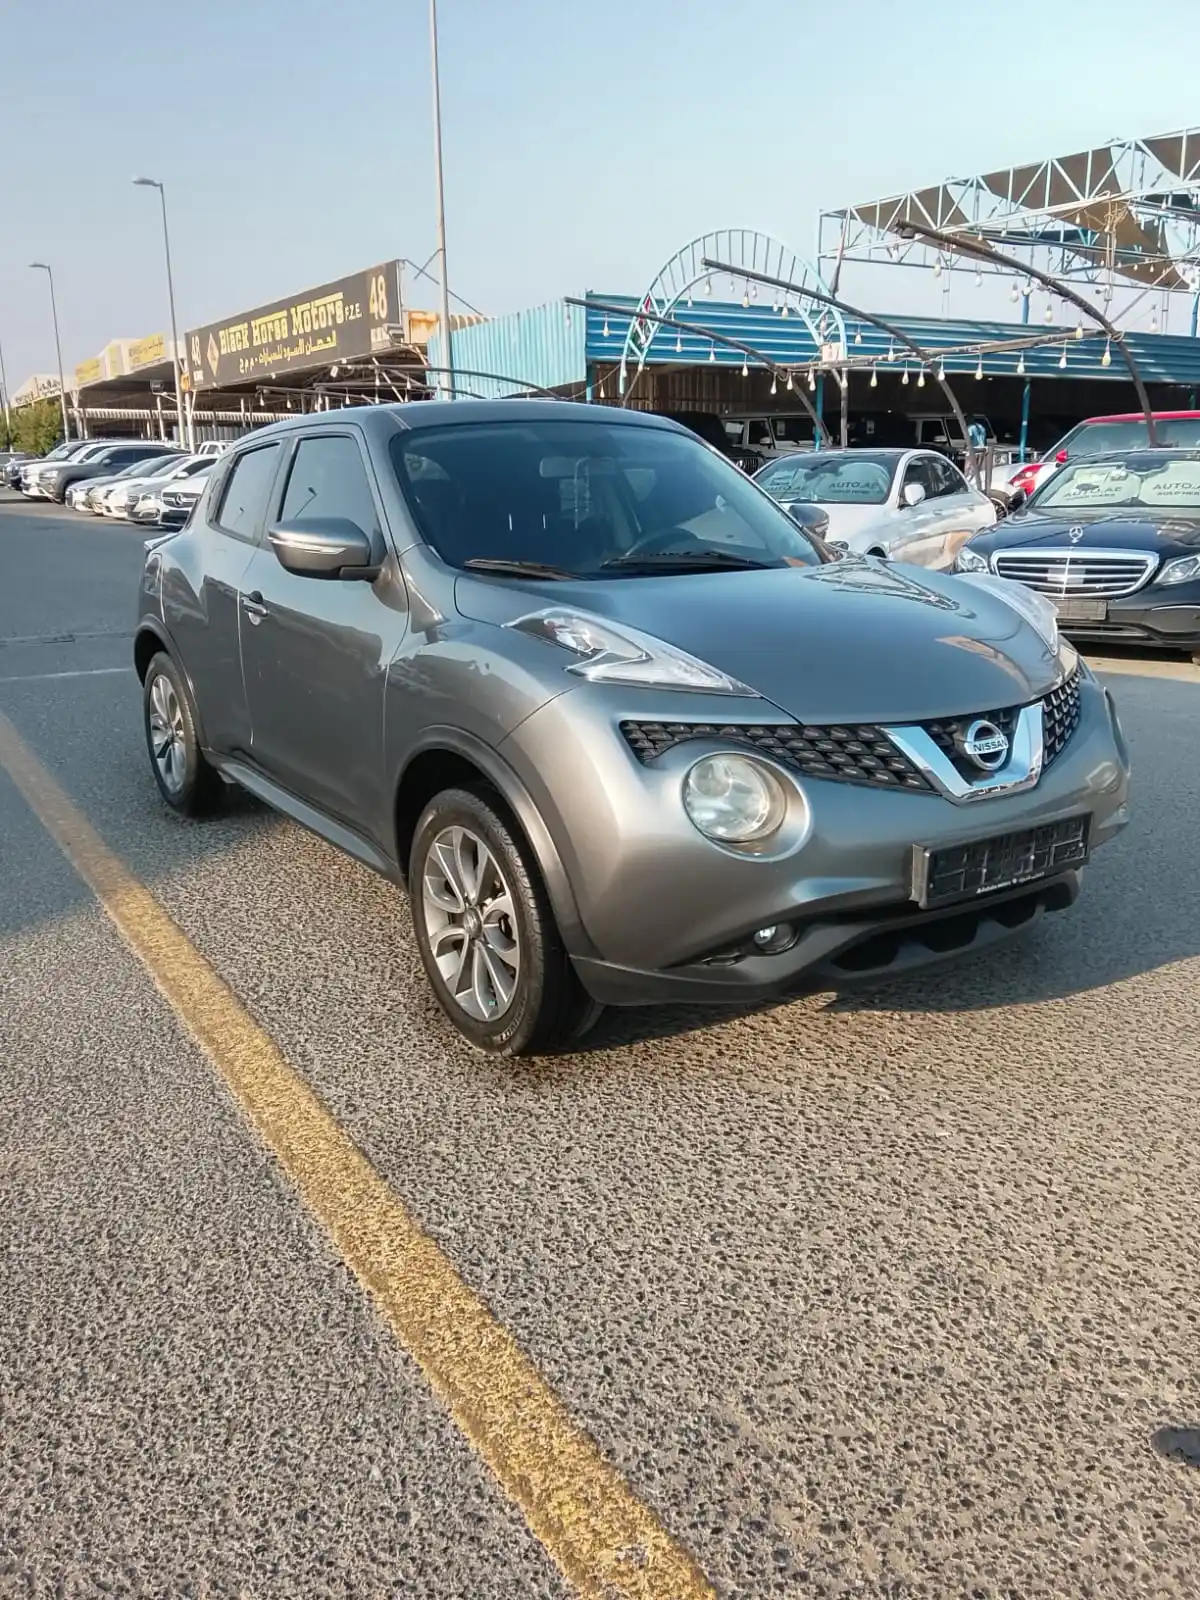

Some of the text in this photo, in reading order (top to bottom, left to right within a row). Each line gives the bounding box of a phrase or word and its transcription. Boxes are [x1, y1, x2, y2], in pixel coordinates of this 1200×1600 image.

[369, 274, 388, 320] 48
[218, 322, 250, 355] Black
[290, 292, 344, 336] Motors
[191, 335, 202, 366] 48
[973, 738, 1008, 752] NISSAN
